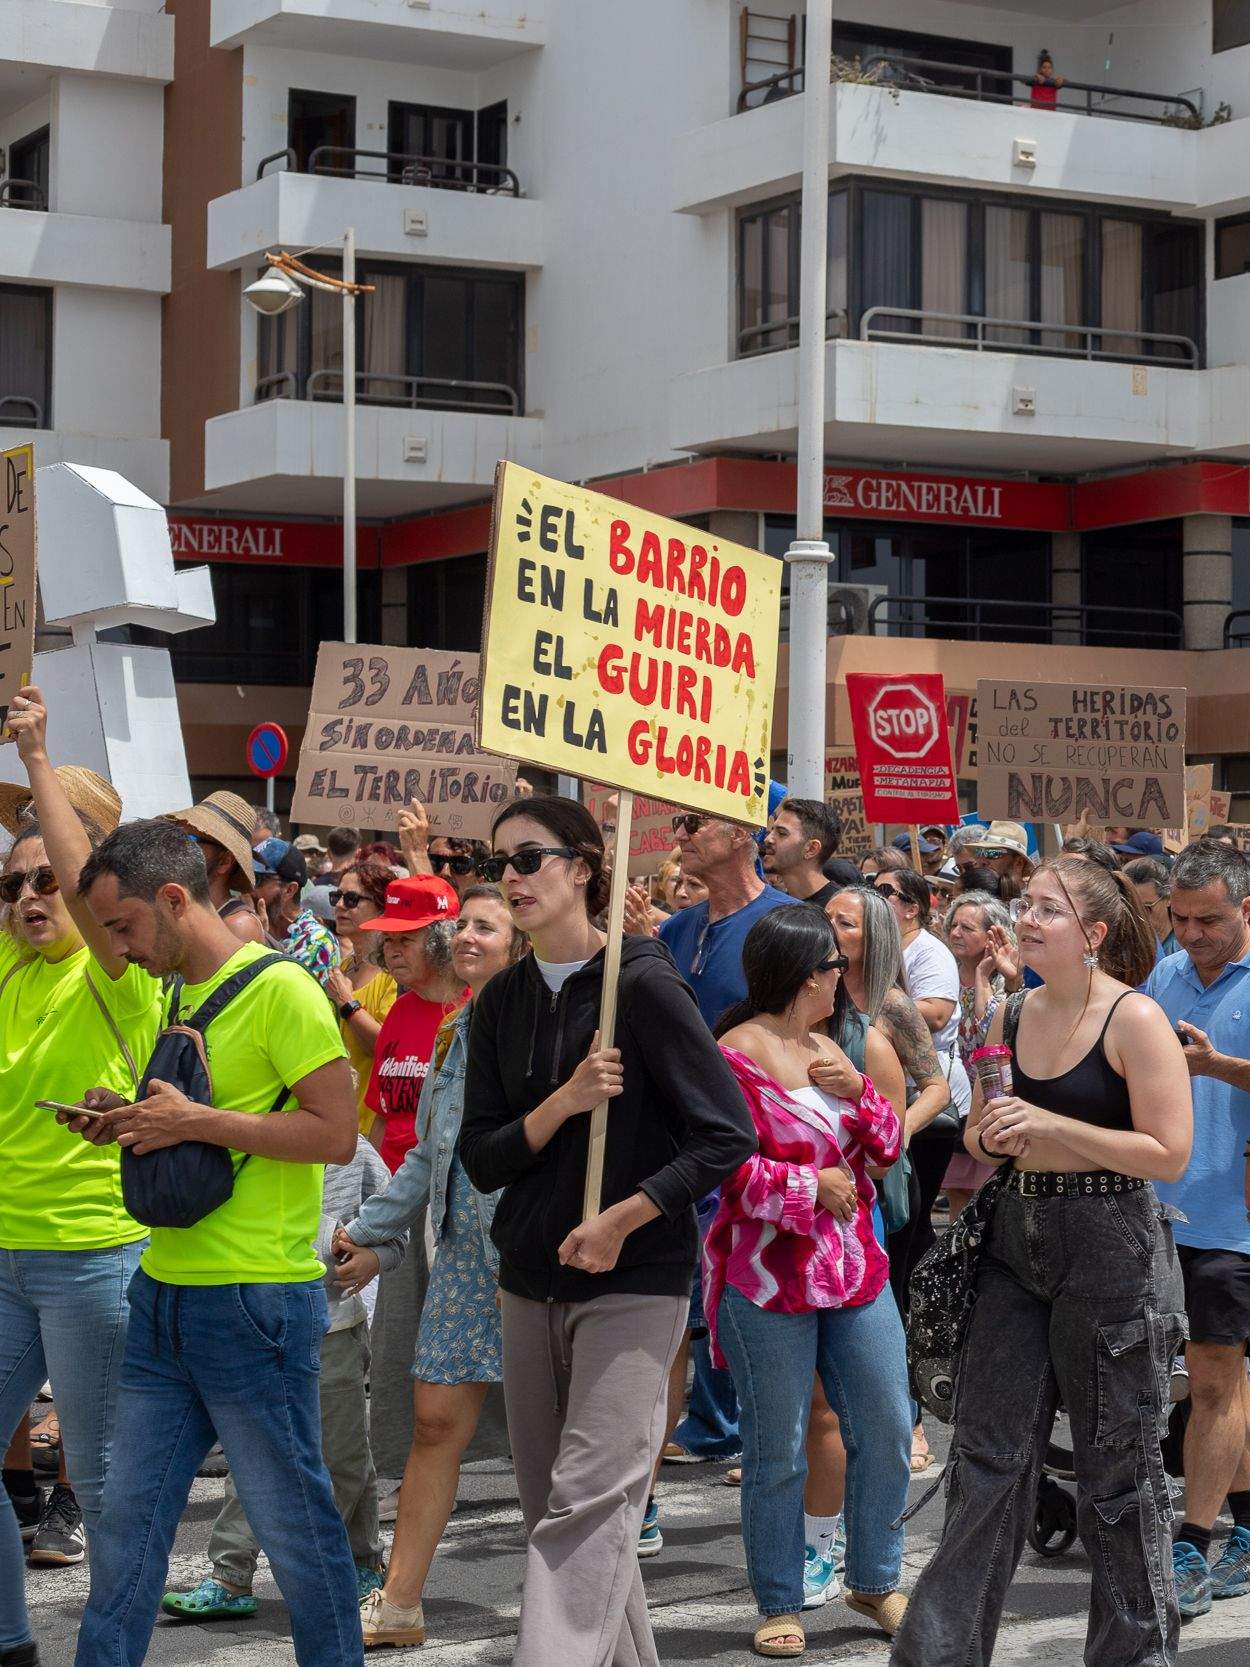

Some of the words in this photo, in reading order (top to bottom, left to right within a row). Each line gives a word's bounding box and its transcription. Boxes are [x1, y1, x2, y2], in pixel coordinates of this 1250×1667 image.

[857, 478, 1002, 518] GENERALI
[169, 524, 283, 556] ENERALI
[540, 505, 584, 560] EL
[610, 520, 746, 616] BARRIO
[517, 558, 565, 612] EN
[583, 578, 619, 627] LA
[634, 598, 755, 678] MIERDA
[338, 657, 391, 709] 33
[402, 659, 480, 706] AÑO
[533, 630, 572, 680] EL
[597, 644, 712, 723] GUIRI
[994, 688, 1038, 711] LAS
[1073, 688, 1173, 719] HERIDAS
[876, 708, 929, 736] STOP
[1000, 717, 1031, 737] del
[375, 725, 484, 755] ORDENA
[501, 684, 549, 737] EN
[563, 700, 607, 753] LA
[627, 720, 751, 796] GLORIA
[987, 742, 1015, 764] NO
[1029, 744, 1049, 765] SE
[308, 768, 349, 798] EL
[1008, 772, 1170, 820] NUNCA
[378, 1056, 430, 1078] Manifies
